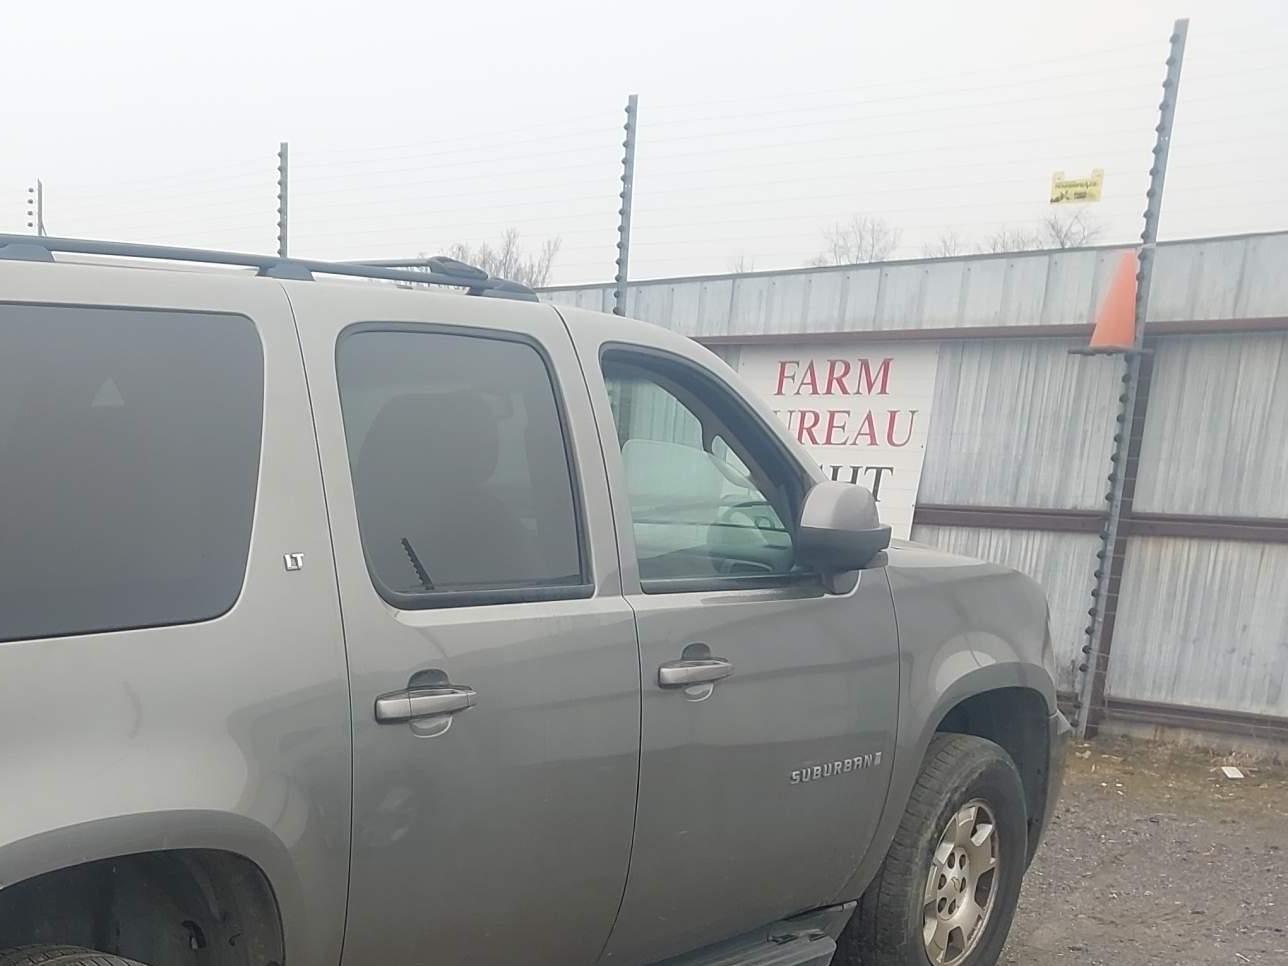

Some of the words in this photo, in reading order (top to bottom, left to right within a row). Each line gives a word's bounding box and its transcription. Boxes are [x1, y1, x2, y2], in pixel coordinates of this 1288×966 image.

[774, 358, 894, 396] FARM
[283, 553, 304, 571] LT
[790, 754, 873, 785] SUBURBAN
